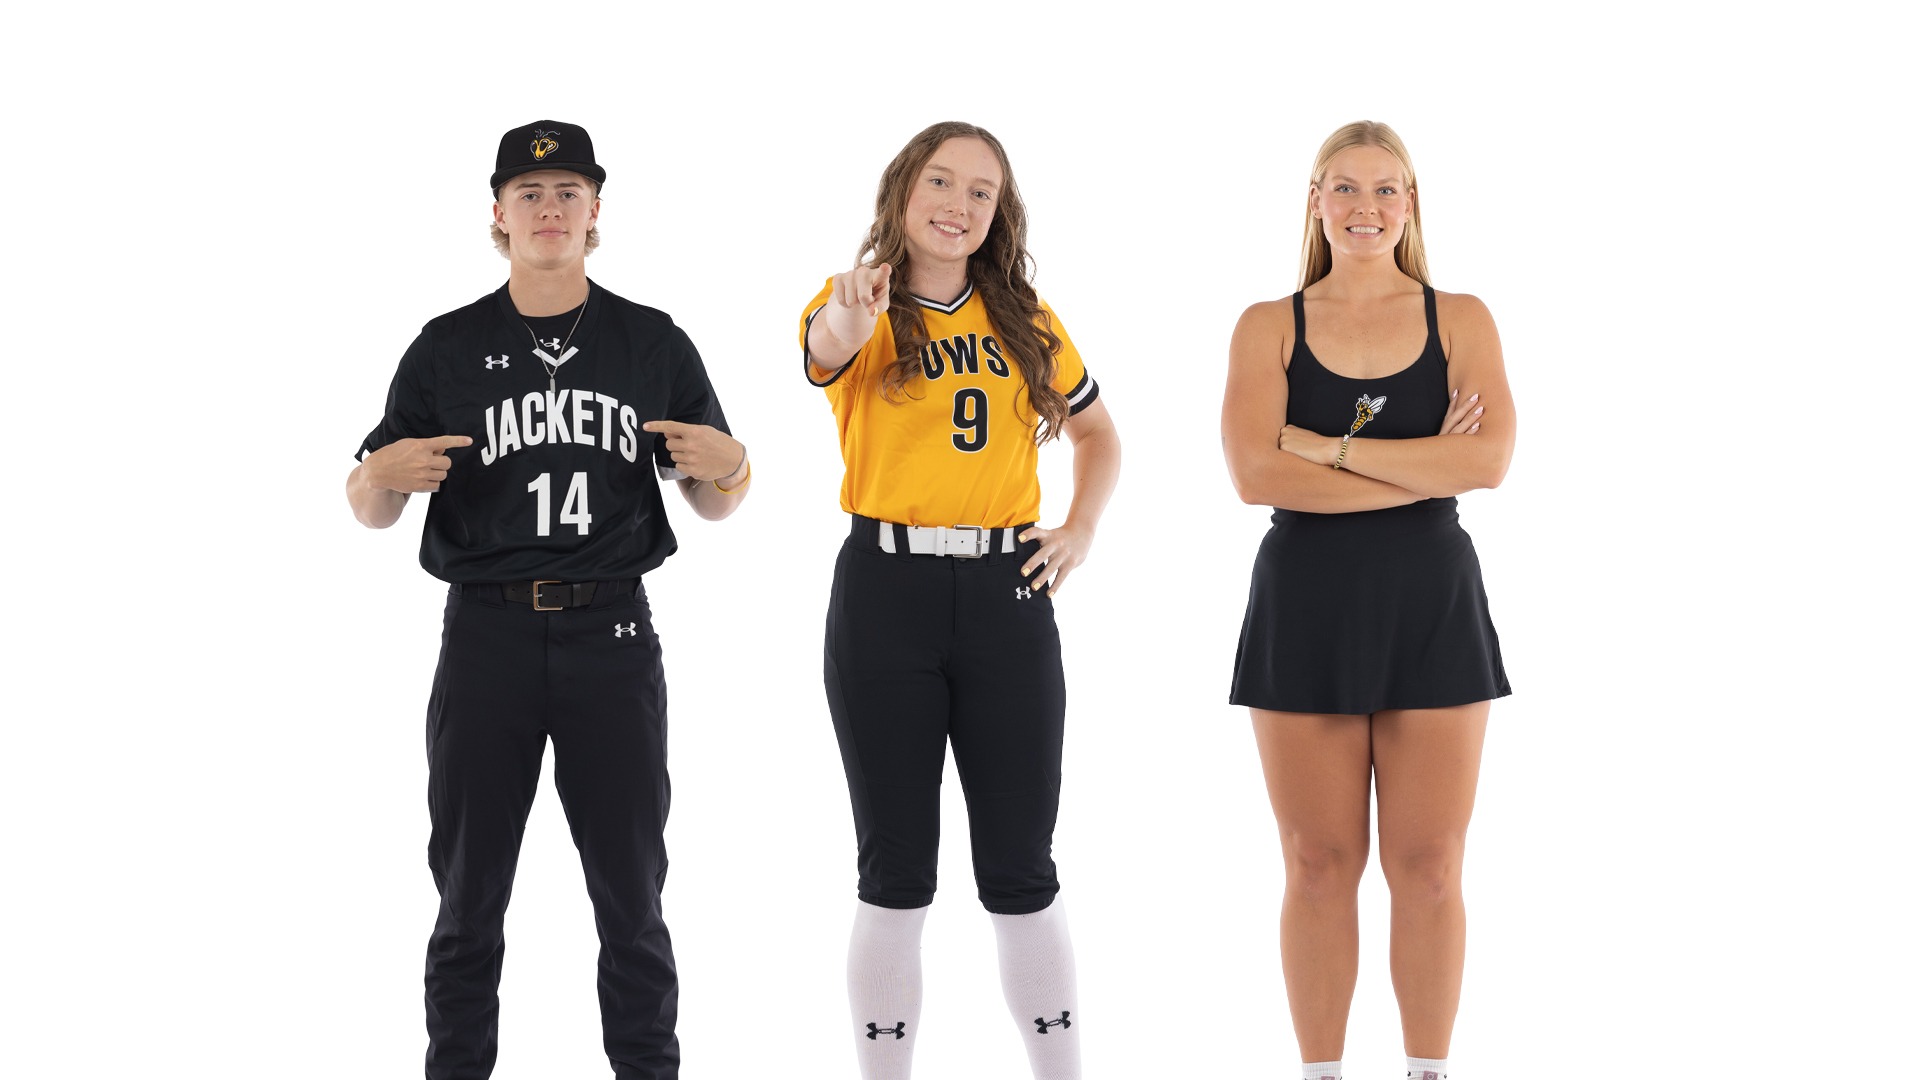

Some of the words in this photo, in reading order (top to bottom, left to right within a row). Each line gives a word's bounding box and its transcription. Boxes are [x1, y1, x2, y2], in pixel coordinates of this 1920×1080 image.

[919, 333, 1010, 380] UWS
[481, 389, 638, 466] JACKETS
[951, 387, 989, 454] 9
[528, 472, 592, 536] 14
